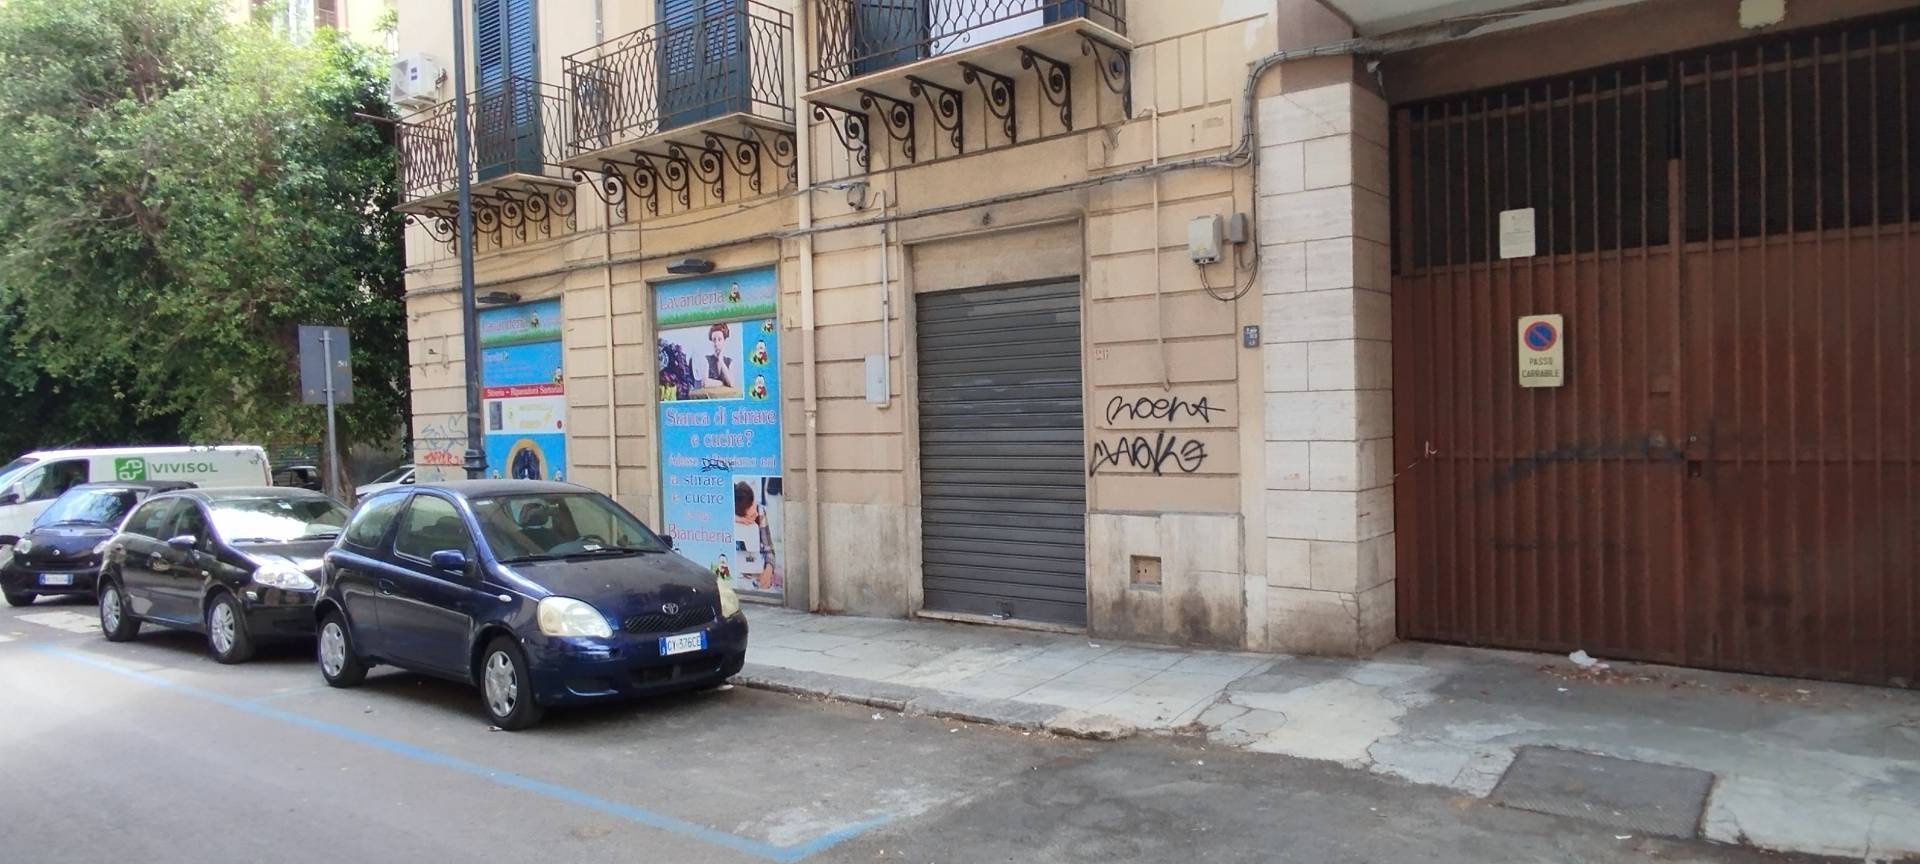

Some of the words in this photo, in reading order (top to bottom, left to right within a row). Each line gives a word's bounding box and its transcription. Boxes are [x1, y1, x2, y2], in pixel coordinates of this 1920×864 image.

[658, 288, 724, 310] Lavanderia
[1529, 357, 1553, 366] PASSO
[1521, 369, 1560, 378] CARRABILE
[665, 408, 709, 426] Stanca
[714, 406, 725, 425] di
[731, 407, 776, 425] stirare
[690, 435, 699, 448] e
[703, 430, 754, 448] cucire?
[152, 462, 218, 473] VIVISOL
[684, 474, 725, 486] stirare
[685, 491, 725, 504] cucire
[668, 523, 732, 543] Biancheria
